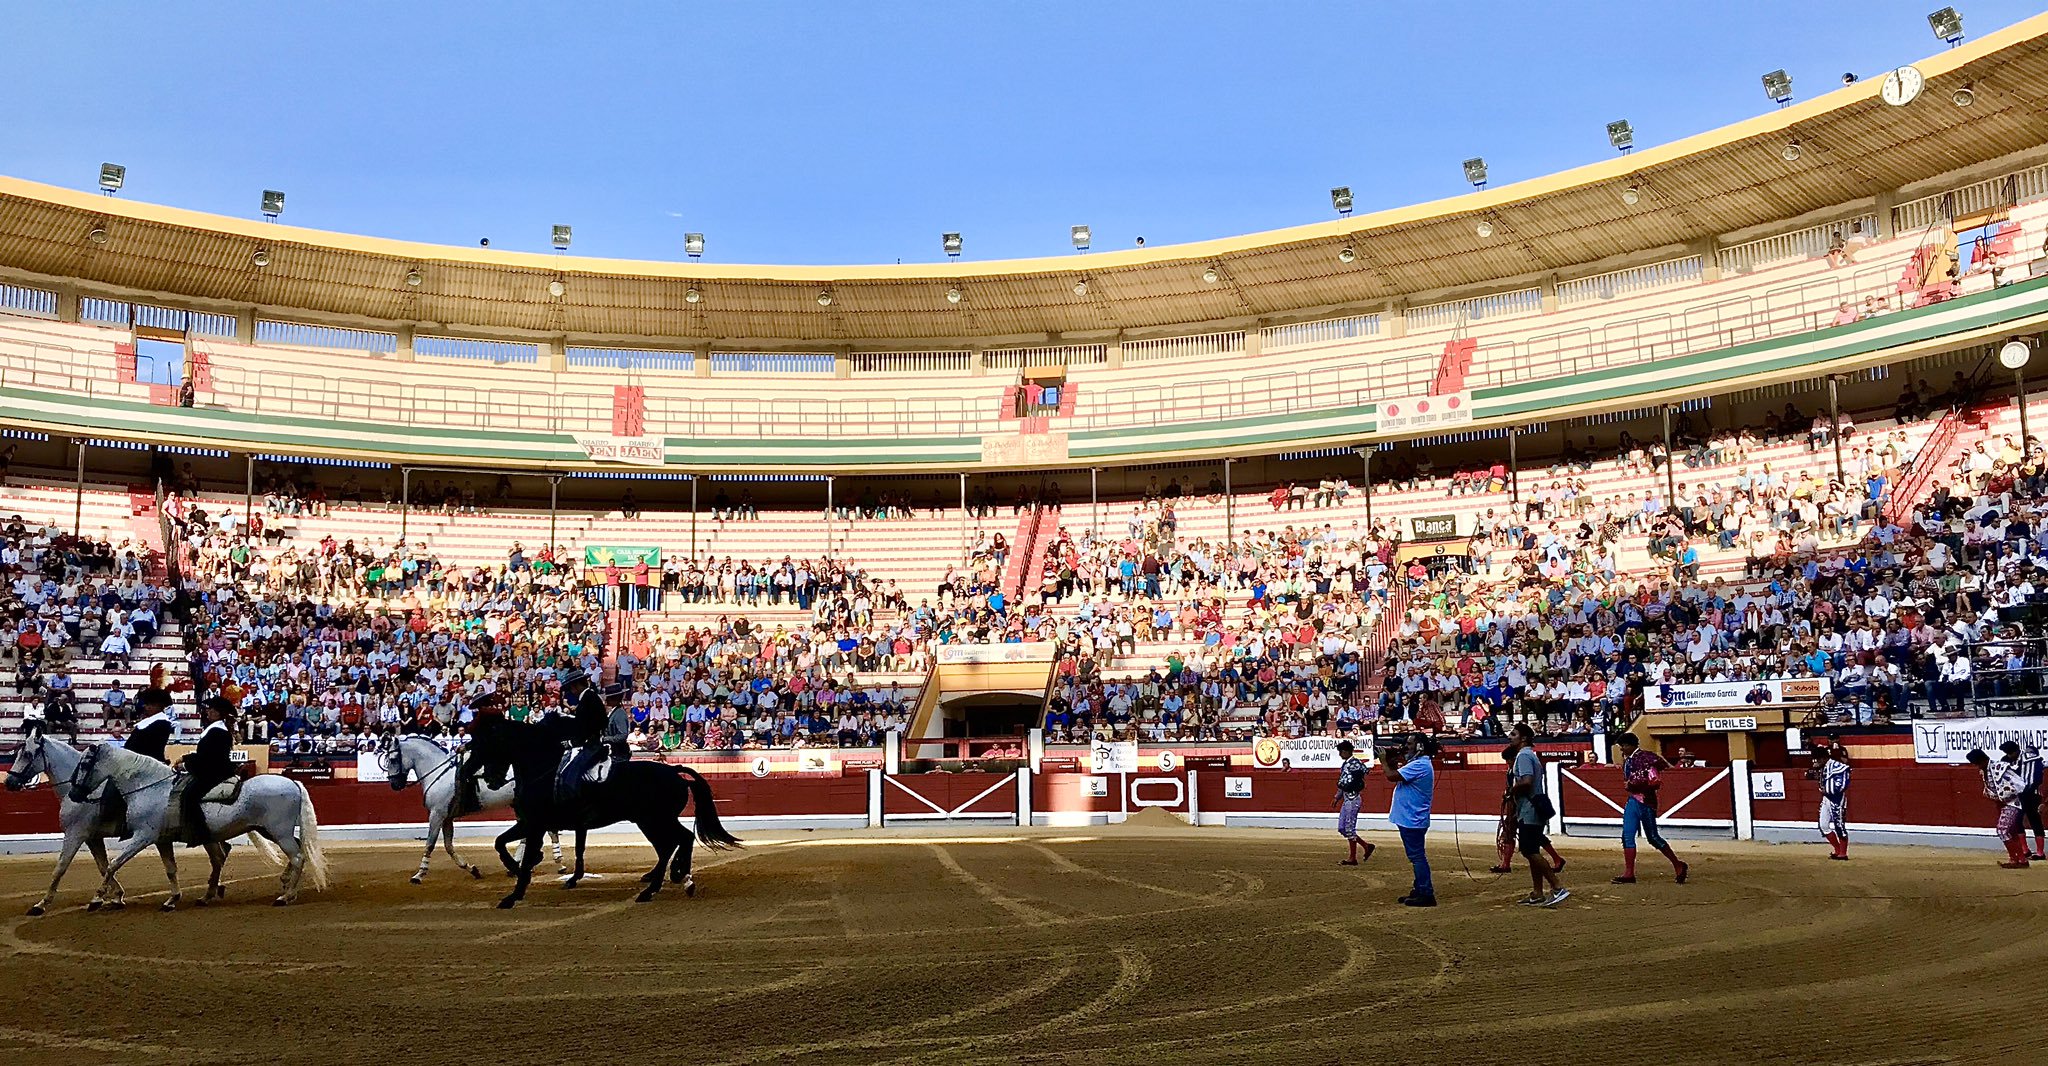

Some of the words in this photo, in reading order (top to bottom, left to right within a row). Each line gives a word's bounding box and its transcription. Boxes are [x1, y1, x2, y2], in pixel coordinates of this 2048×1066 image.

[621, 446, 661, 459] JAEN
[1415, 519, 1453, 533] Blanca
[1686, 690, 1716, 699] Guillermo
[1707, 718, 1754, 729] TORILES
[1946, 726, 1997, 751] FEDERACIÓN
[2036, 729, 2048, 750] DE
[1279, 740, 1308, 751] CIRCULO
[1163, 754, 1171, 768] 5
[1301, 753, 1310, 762] de
[1310, 753, 1331, 762] JAEN
[757, 760, 765, 774] 4
